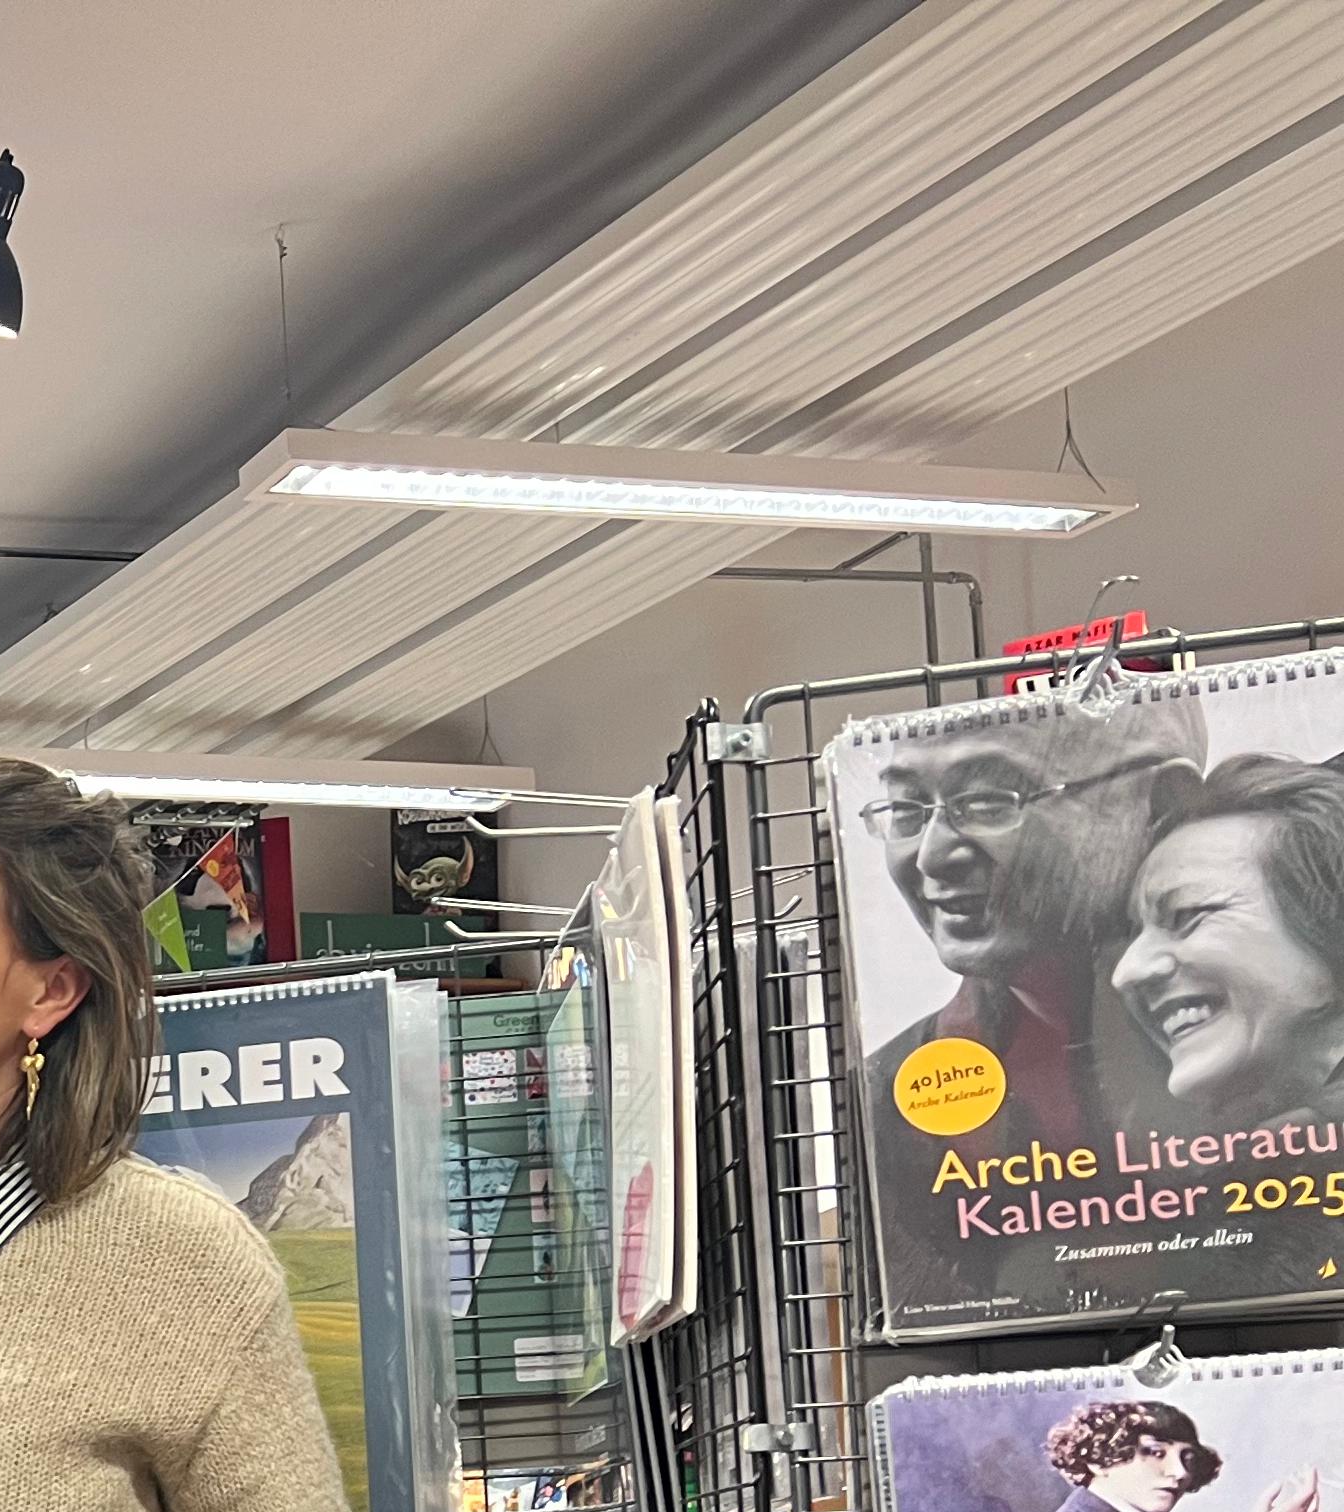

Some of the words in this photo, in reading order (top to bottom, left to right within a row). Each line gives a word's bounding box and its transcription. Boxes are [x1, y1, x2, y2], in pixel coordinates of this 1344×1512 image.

[1025, 636, 1063, 653] AZAR
[140, 1037, 351, 1115] ERER
[909, 1076, 933, 1094] 40
[933, 1063, 985, 1091] Jahre
[908, 1097, 941, 1112] Arche
[944, 1085, 996, 1105] Kalender
[932, 1141, 1098, 1193] Arche
[1115, 1122, 1344, 1174] Literatu
[957, 1180, 1209, 1239] Kalender
[1222, 1171, 1344, 1217] 2025
[1054, 1238, 1153, 1263] Zusammen
[1158, 1234, 1199, 1253] oder
[1203, 1228, 1254, 1247] allein
